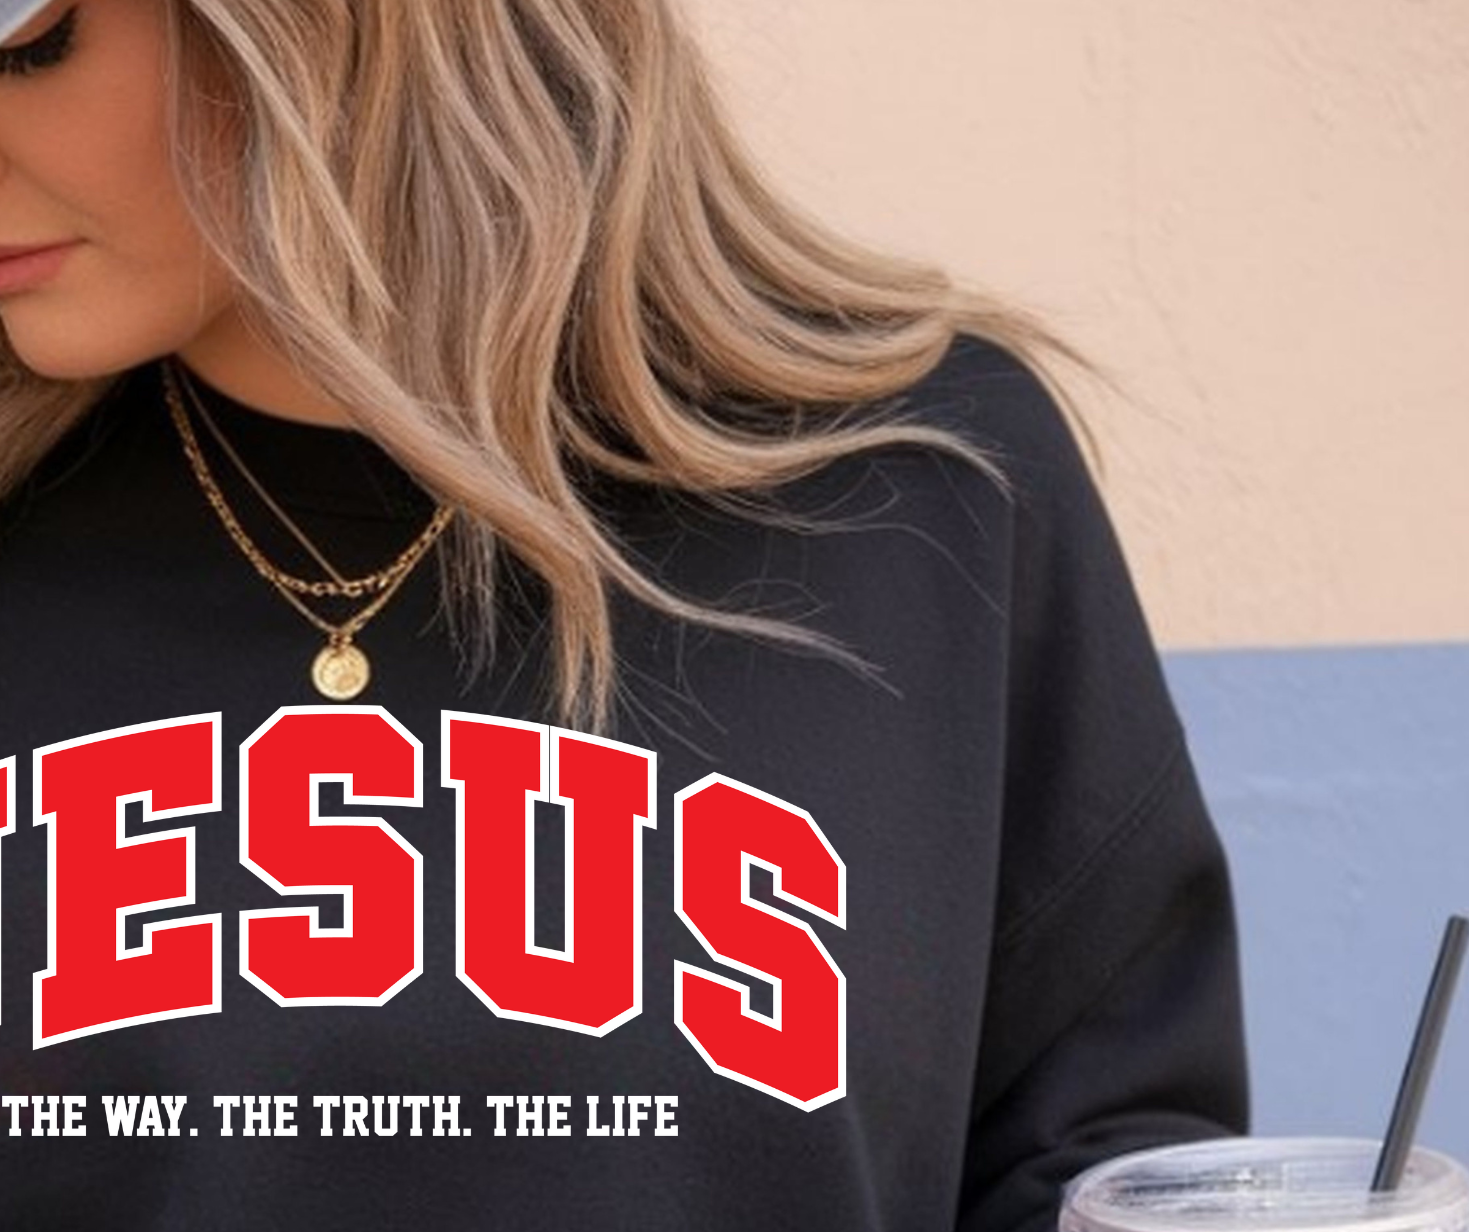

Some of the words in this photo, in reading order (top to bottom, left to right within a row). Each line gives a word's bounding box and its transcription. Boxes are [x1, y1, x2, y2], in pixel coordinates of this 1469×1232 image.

[1, 1095, 87, 1137] THE
[102, 1095, 198, 1137] WAY.
[213, 1095, 298, 1137] THE
[312, 1095, 472, 1137] TRUTH.
[486, 1095, 572, 1137] THE
[586, 1095, 679, 1137] LIFE
